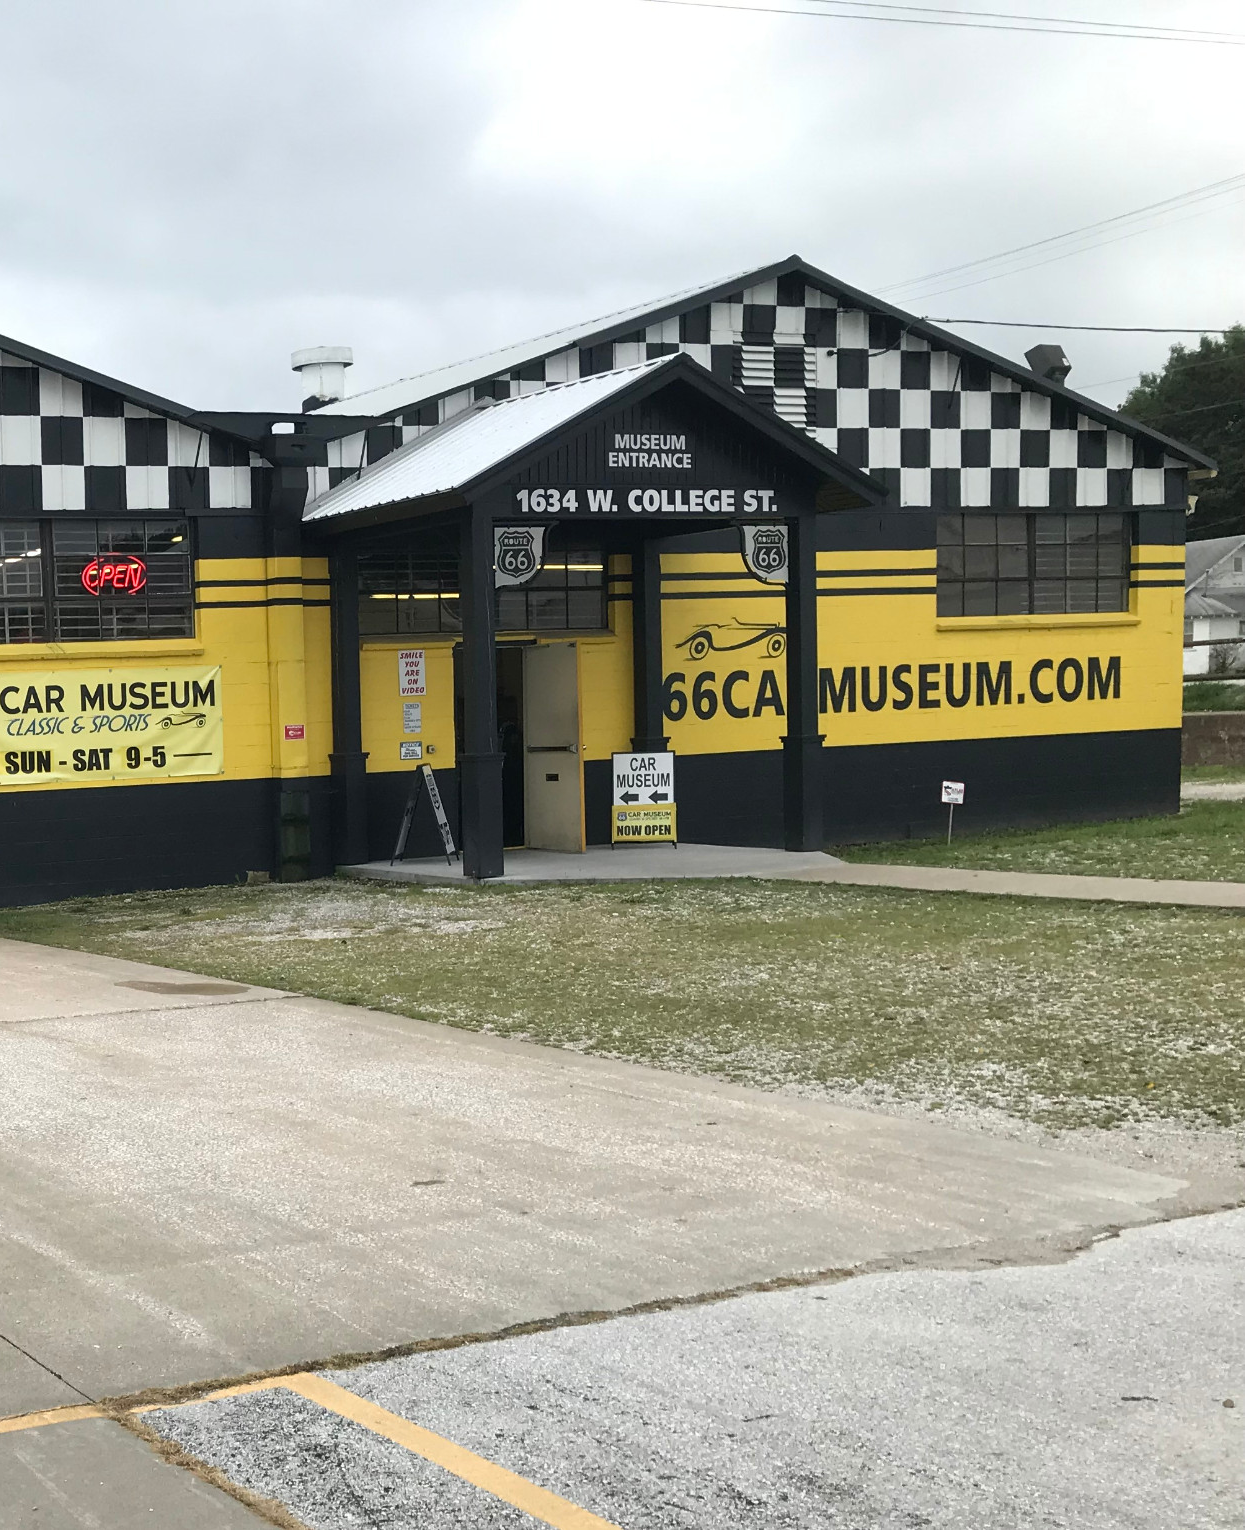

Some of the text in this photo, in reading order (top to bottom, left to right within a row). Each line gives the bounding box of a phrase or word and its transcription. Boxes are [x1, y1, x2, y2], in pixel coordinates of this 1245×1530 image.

[614, 434, 686, 450] MUSEUM
[608, 452, 692, 468] ENTRANCE
[516, 488, 778, 513] 1634 W. COLLEGE ST.
[504, 551, 528, 570] 66
[758, 548, 780, 566] 66
[86, 564, 142, 588] OPEN
[0, 680, 216, 714] CAR MUSEUM
[6, 714, 152, 737] CLASSIC & SPORTS
[5, 750, 52, 774] SUN
[72, 748, 113, 772] SAT
[126, 745, 167, 769] 9-5
[630, 757, 656, 771] CAR
[616, 773, 670, 788] MUSEUM
[617, 825, 671, 836] NOW OPEN
